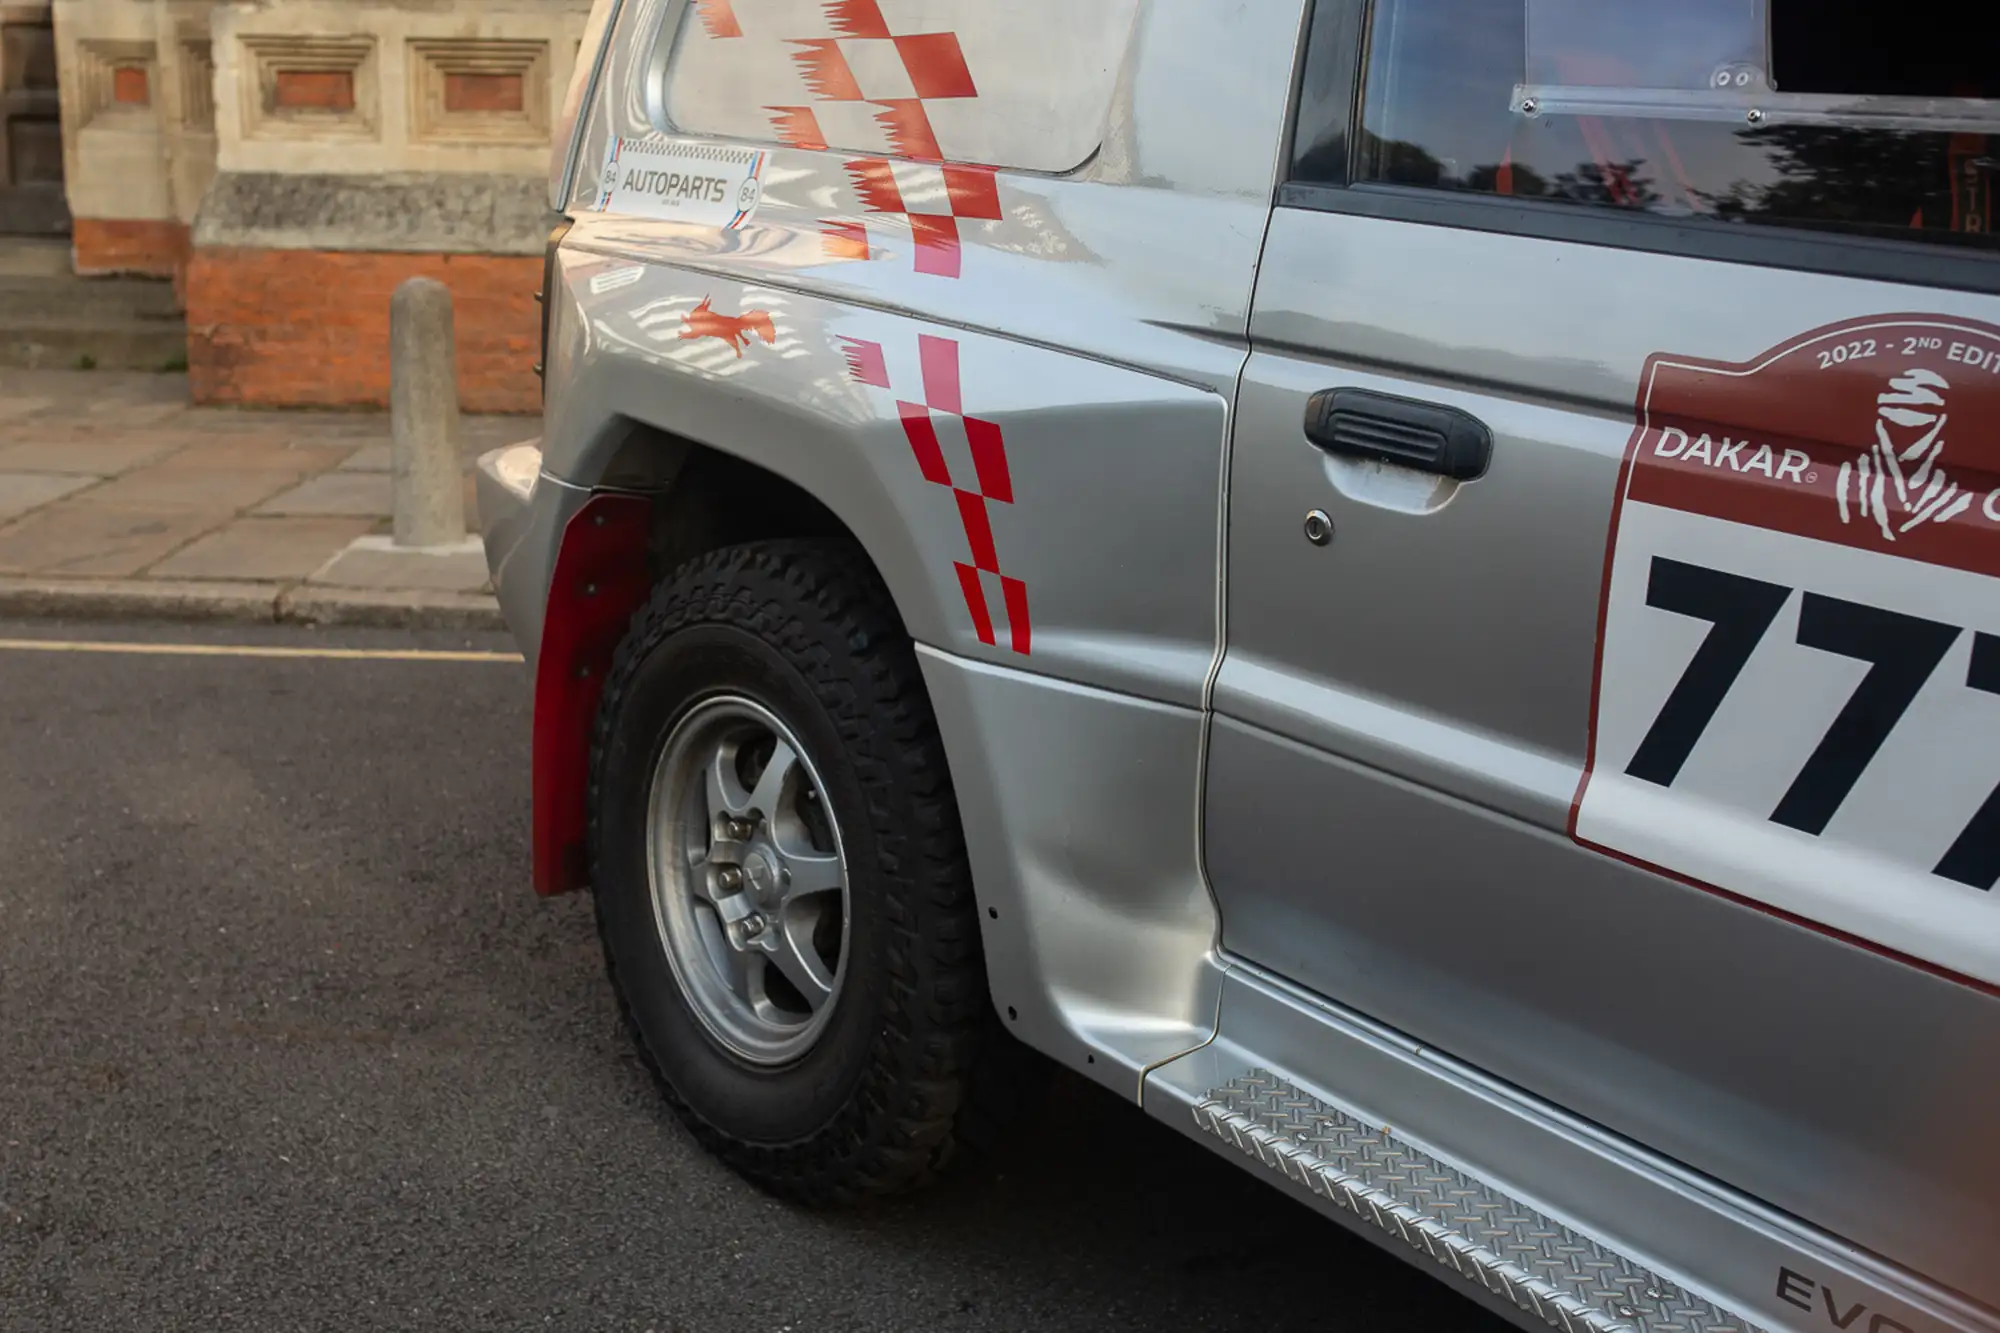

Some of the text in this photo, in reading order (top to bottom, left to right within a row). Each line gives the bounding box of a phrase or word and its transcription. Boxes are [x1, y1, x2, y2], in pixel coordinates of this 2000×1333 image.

[604, 170, 617, 184] 84
[622, 168, 728, 203] AUTOPARTS
[740, 187, 755, 203] 84
[1816, 339, 1877, 370] 2022
[1653, 426, 1810, 484] DAKAR
